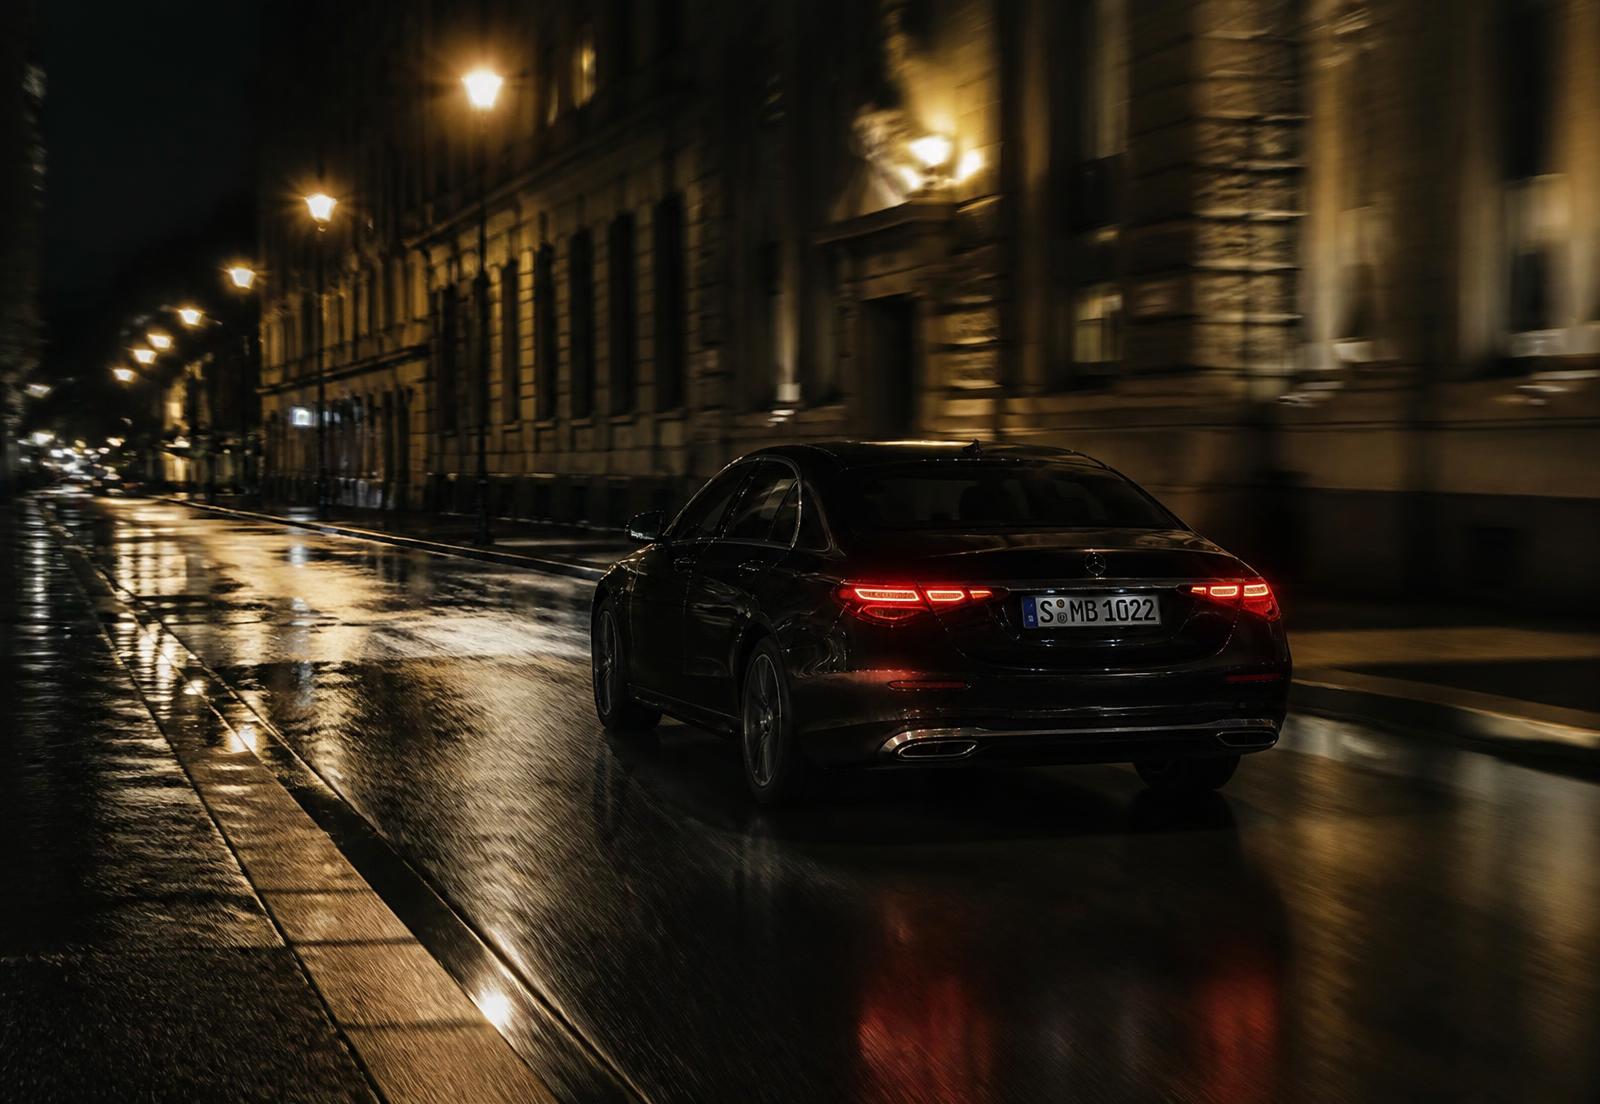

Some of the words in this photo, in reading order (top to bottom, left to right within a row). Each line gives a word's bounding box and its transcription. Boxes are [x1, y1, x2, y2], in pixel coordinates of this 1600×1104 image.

[1040, 600, 1054, 623] S
[1069, 600, 1099, 622] MB
[1102, 599, 1156, 622] 1022
